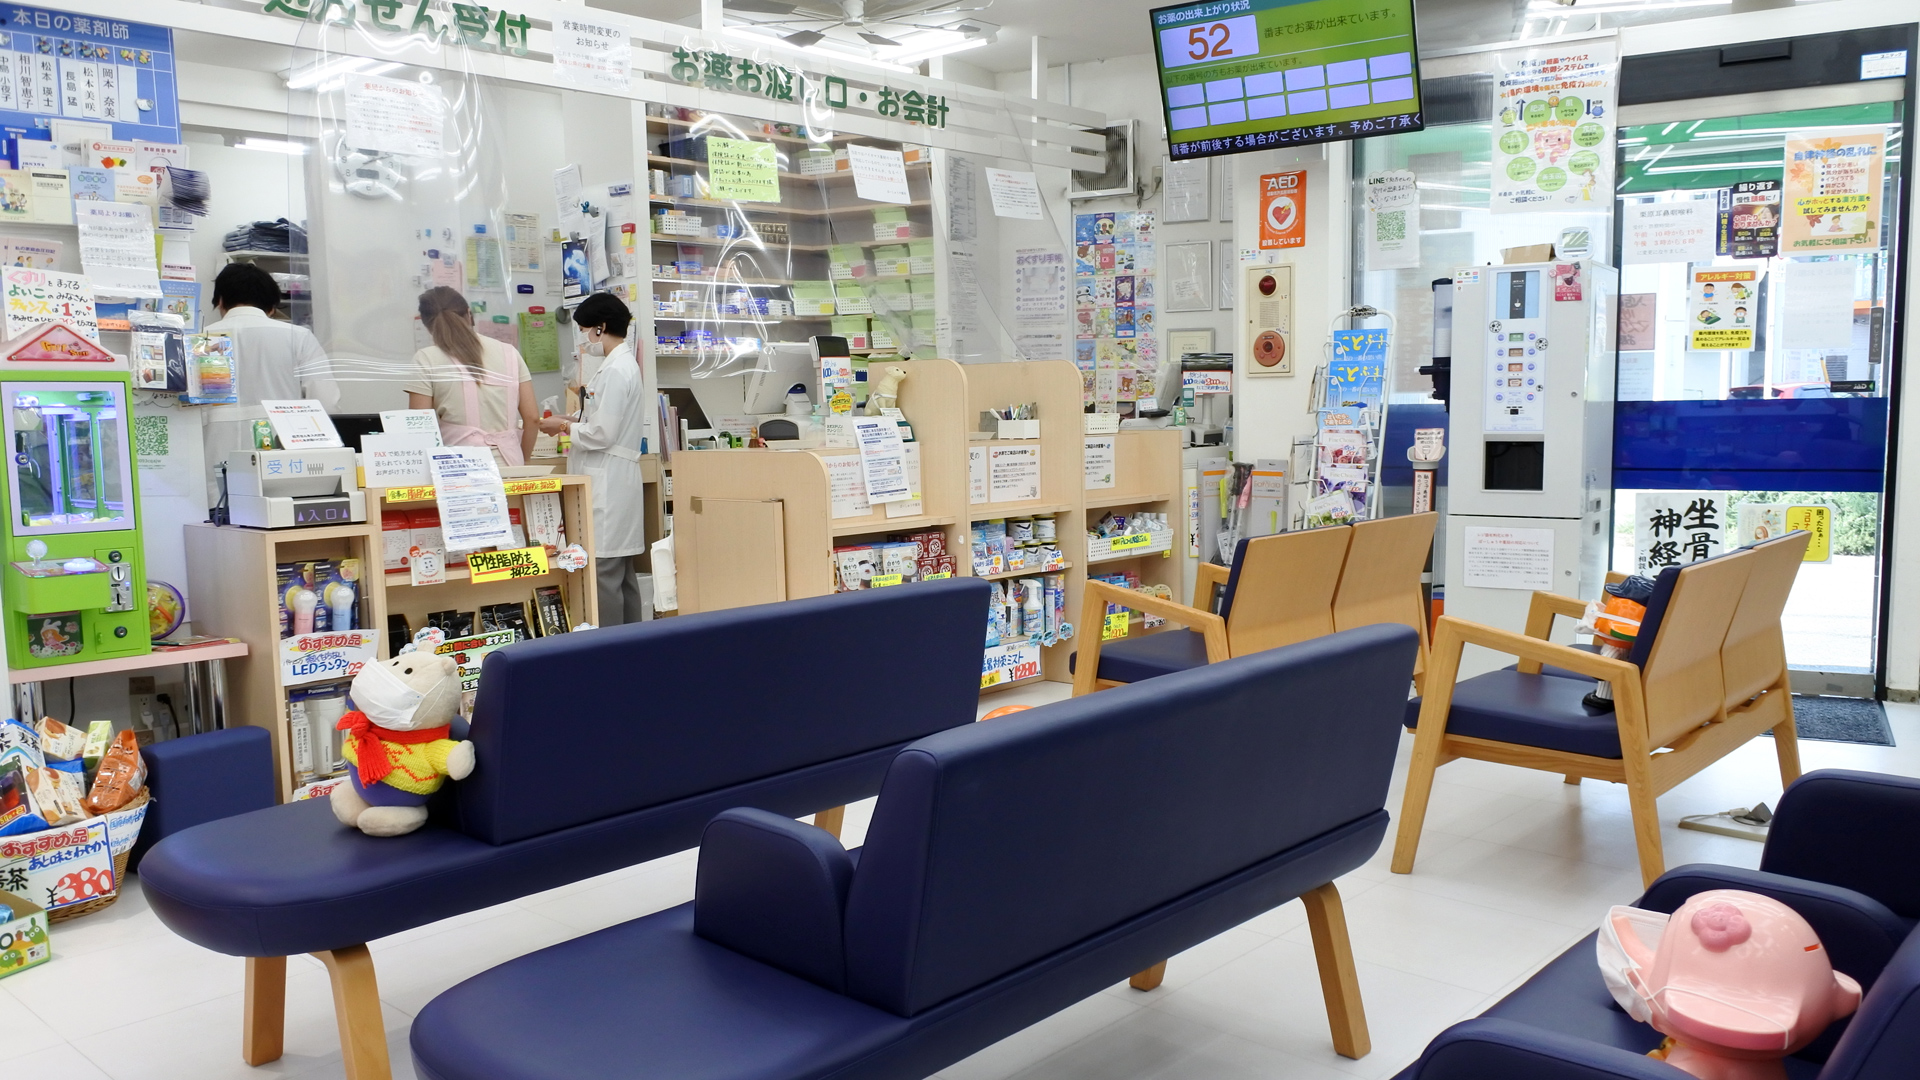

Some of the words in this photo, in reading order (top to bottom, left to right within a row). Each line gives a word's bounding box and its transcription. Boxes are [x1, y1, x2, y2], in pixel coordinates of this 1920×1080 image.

[1158, 1, 1250, 25] お薬の出来上がり状況
[12, 8, 130, 40] 本日の薬剤師
[562, 20, 621, 39] 営業時間変更の
[1263, 8, 1397, 39] 番までお薬が出来ています。
[576, 37, 609, 51] お知らせ
[1188, 22, 1233, 61] 52
[41, 61, 52, 81] 松本
[103, 68, 115, 89] 岡本
[1166, 59, 1302, 84] 以下の番号の方もお薬が出来ています。
[0, 76, 12, 102] 小夜子
[19, 54, 34, 109] 相川智恵子
[66, 71, 77, 92] 長島
[83, 67, 96, 112] 松本美咲
[67, 96, 78, 107] 猛
[104, 96, 116, 119] 奈美
[1172, 113, 1421, 156] 順番が前後する場合がございます。予めご了承く
[1794, 146, 1877, 161] 自律神経の乱れに
[1268, 175, 1298, 191] AED
[1369, 177, 1385, 185] LINE
[1739, 181, 1774, 191] 繰り返す
[1797, 195, 1871, 206] 心がホッとする漢方薬を
[1803, 204, 1866, 214] 試してみませんか？
[90, 209, 140, 218] 薬局よりお願い
[1734, 220, 1777, 228] ありませんか？
[1262, 237, 1302, 247] 設置しています
[1793, 237, 1872, 248] お気軽にご相談下さい
[1016, 253, 1064, 265] おくすり手帳
[1700, 272, 1751, 280] アレルギー対策
[267, 459, 304, 475] 受付
[375, 459, 423, 467] 送られている方は
[308, 508, 337, 522] 入口
[1683, 498, 1720, 562] 坐骨
[1648, 508, 1682, 580] 神経
[470, 551, 534, 571] 中性脂肪を
[298, 634, 363, 652] おすすめ品
[292, 658, 350, 676] LEDランタン
[307, 687, 335, 695] Panasonic
[0, 828, 89, 858] おすすめ品
[28, 841, 109, 871] あと味さわやか
[46, 866, 115, 907] ¥380
